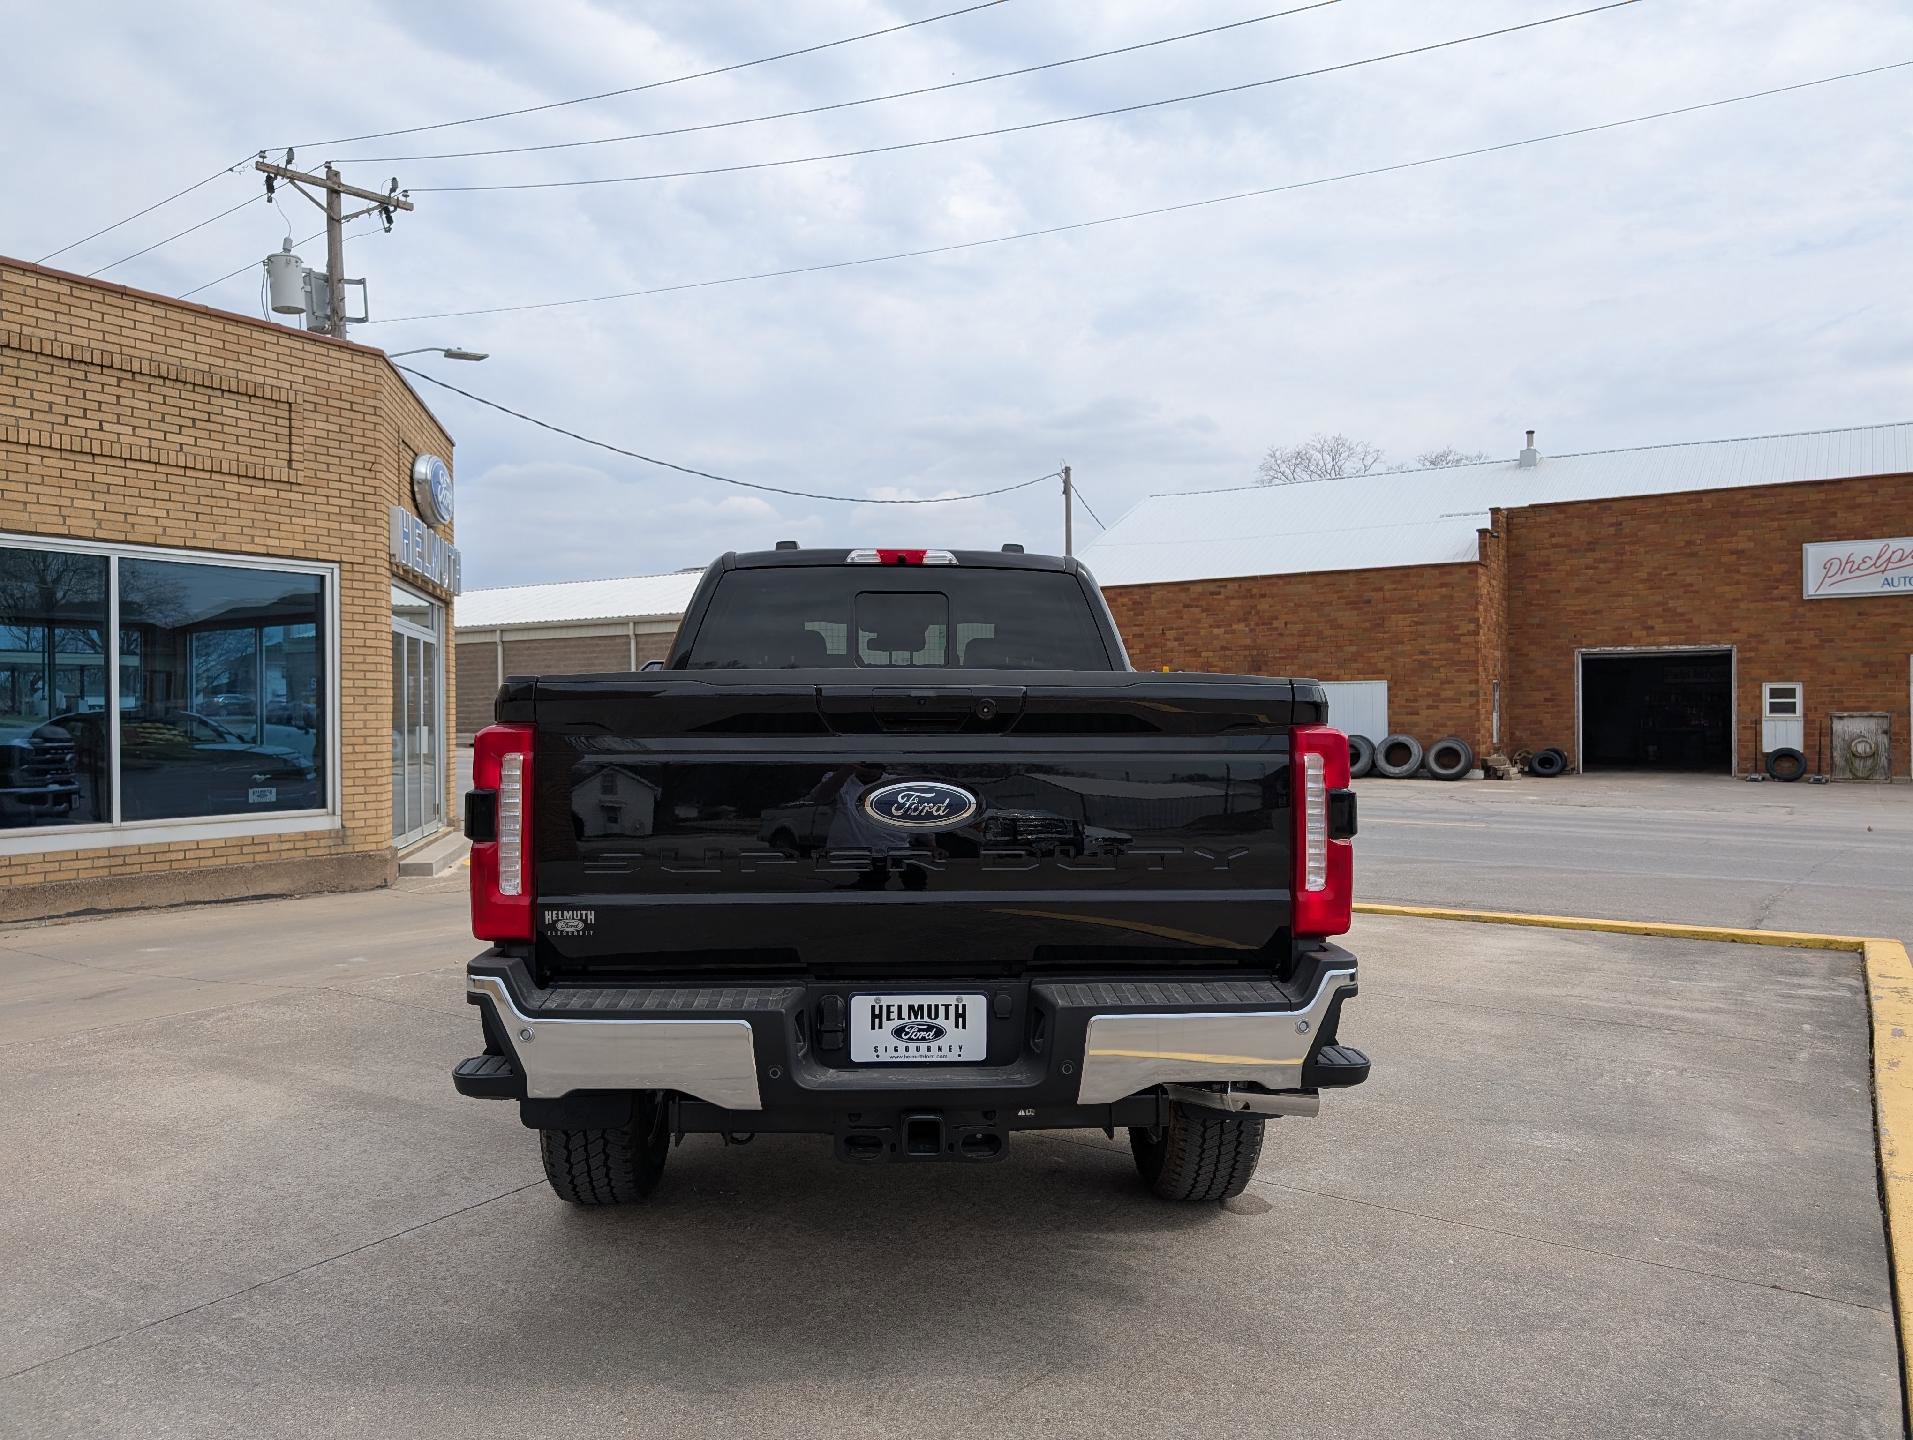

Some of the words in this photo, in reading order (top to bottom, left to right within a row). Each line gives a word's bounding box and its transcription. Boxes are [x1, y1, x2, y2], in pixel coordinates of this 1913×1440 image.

[891, 791, 949, 816] Ford
[544, 910, 595, 925] HELMUTH
[870, 1003, 967, 1031] HELMUTH
[901, 1024, 936, 1040] Ford
[873, 1045, 963, 1054] SIGOURNEY
